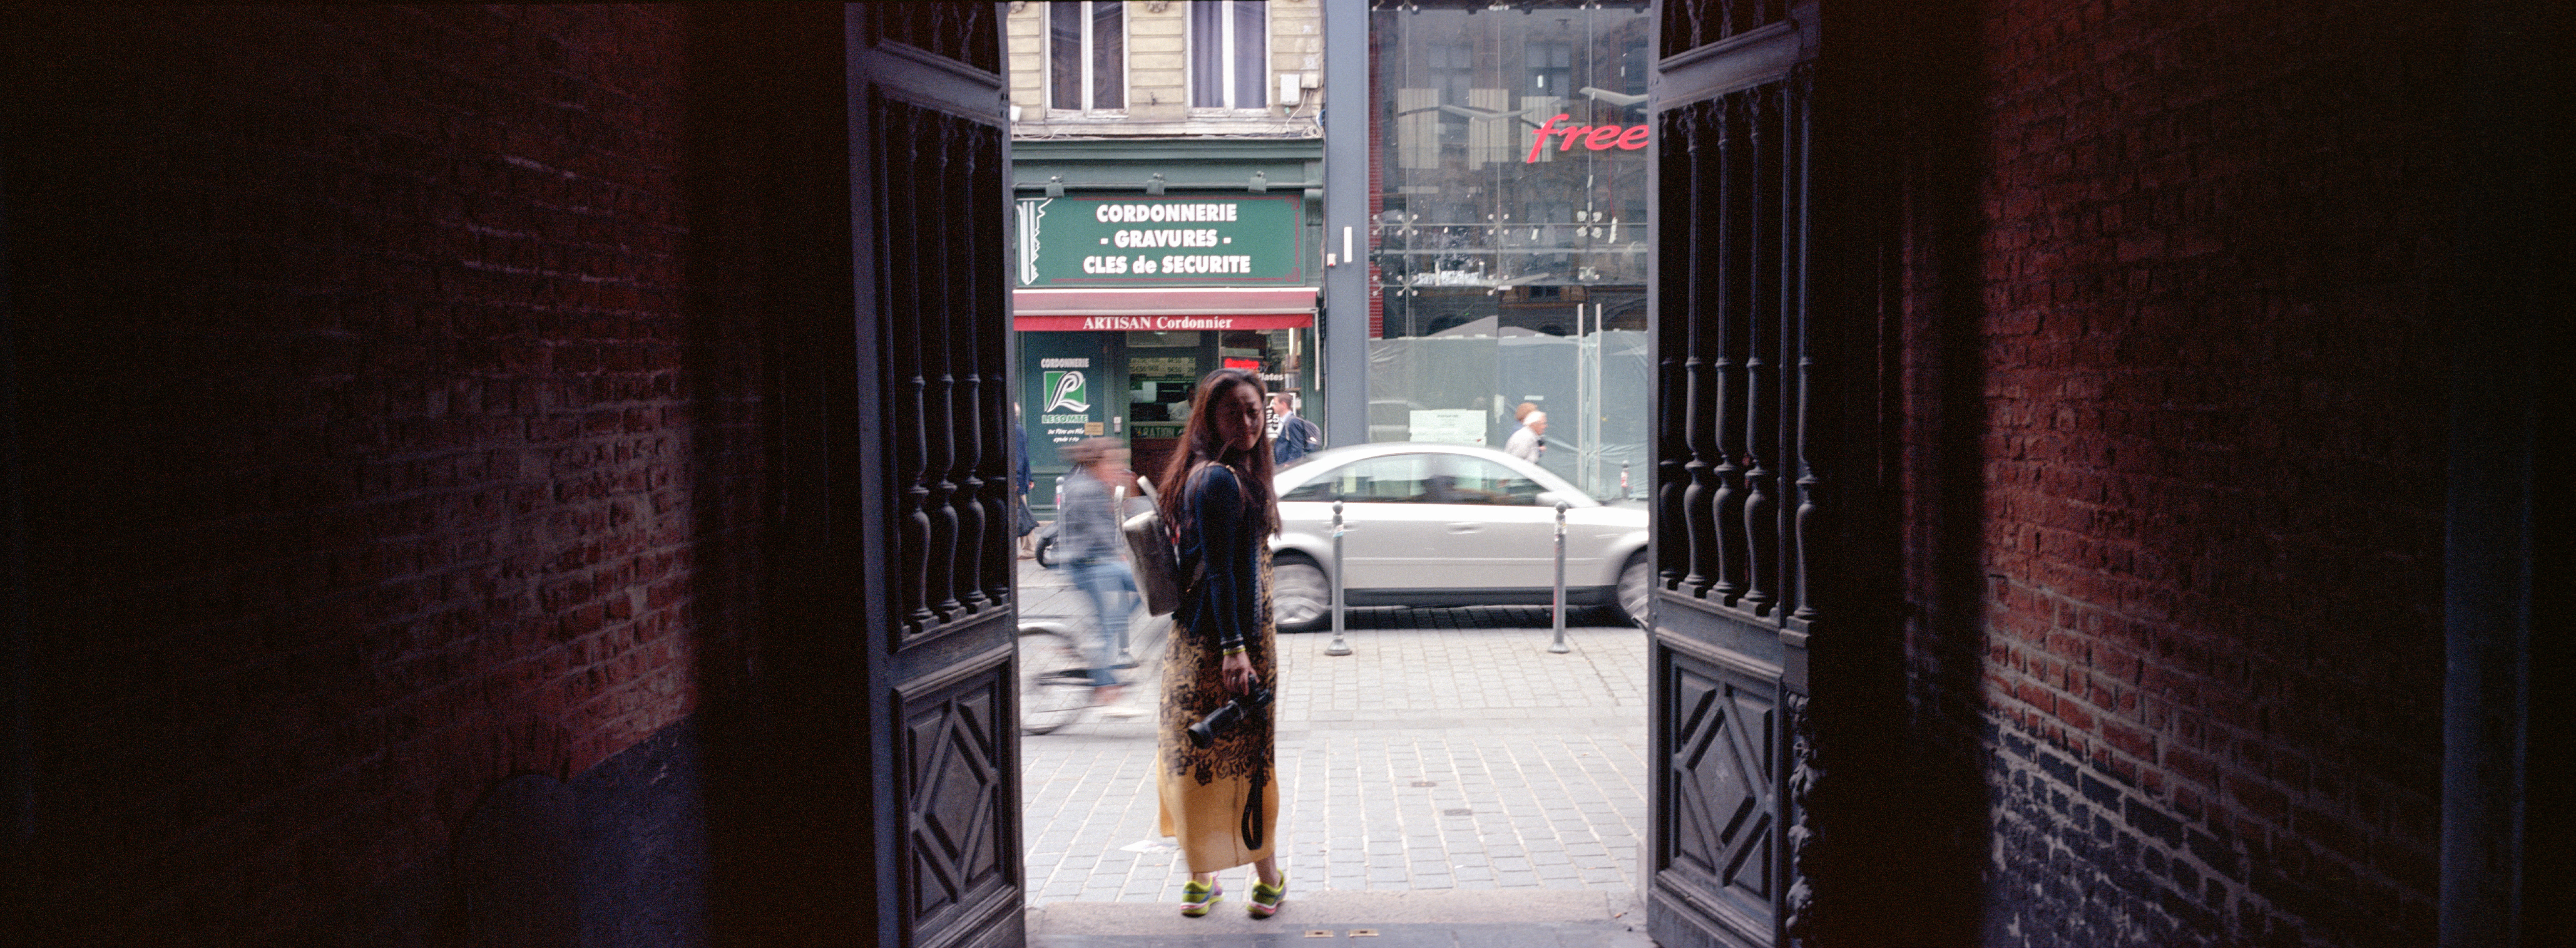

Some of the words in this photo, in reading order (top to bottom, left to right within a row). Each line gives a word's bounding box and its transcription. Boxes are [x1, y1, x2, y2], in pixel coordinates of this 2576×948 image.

[1527, 113, 1649, 164] free
[1096, 203, 1237, 223] CORDONNERIE
[1114, 229, 1218, 248] GRAVURES
[1083, 256, 1128, 274] CLES
[1132, 254, 1157, 274] de
[1161, 255, 1251, 274] SECURITE
[1083, 317, 1151, 330] ARTISAN
[1156, 316, 1233, 330] Cordonnier
[1042, 414, 1089, 424] LECOMTE
